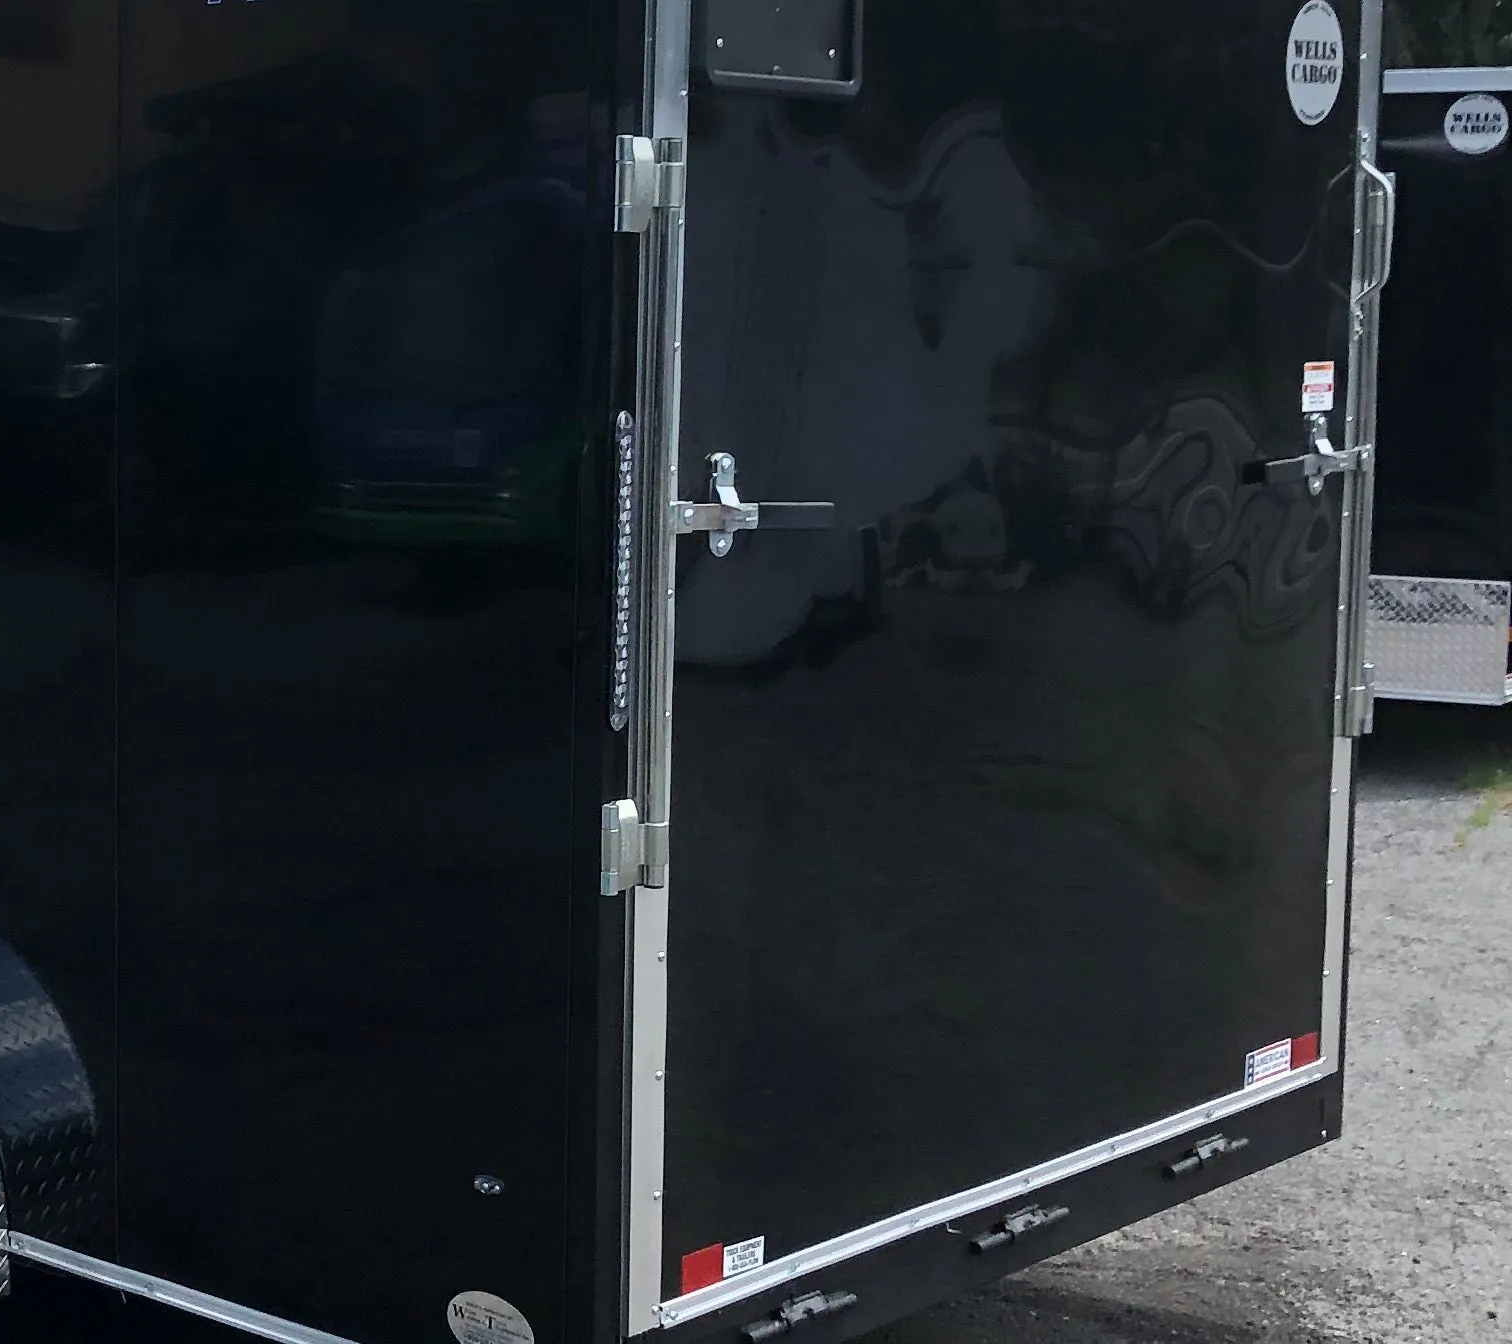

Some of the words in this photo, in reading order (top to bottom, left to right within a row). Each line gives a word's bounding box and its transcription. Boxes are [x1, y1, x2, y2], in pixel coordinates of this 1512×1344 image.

[1293, 39, 1338, 60] WELLS
[1291, 63, 1337, 85] CARGO
[1452, 113, 1502, 123] WELLS
